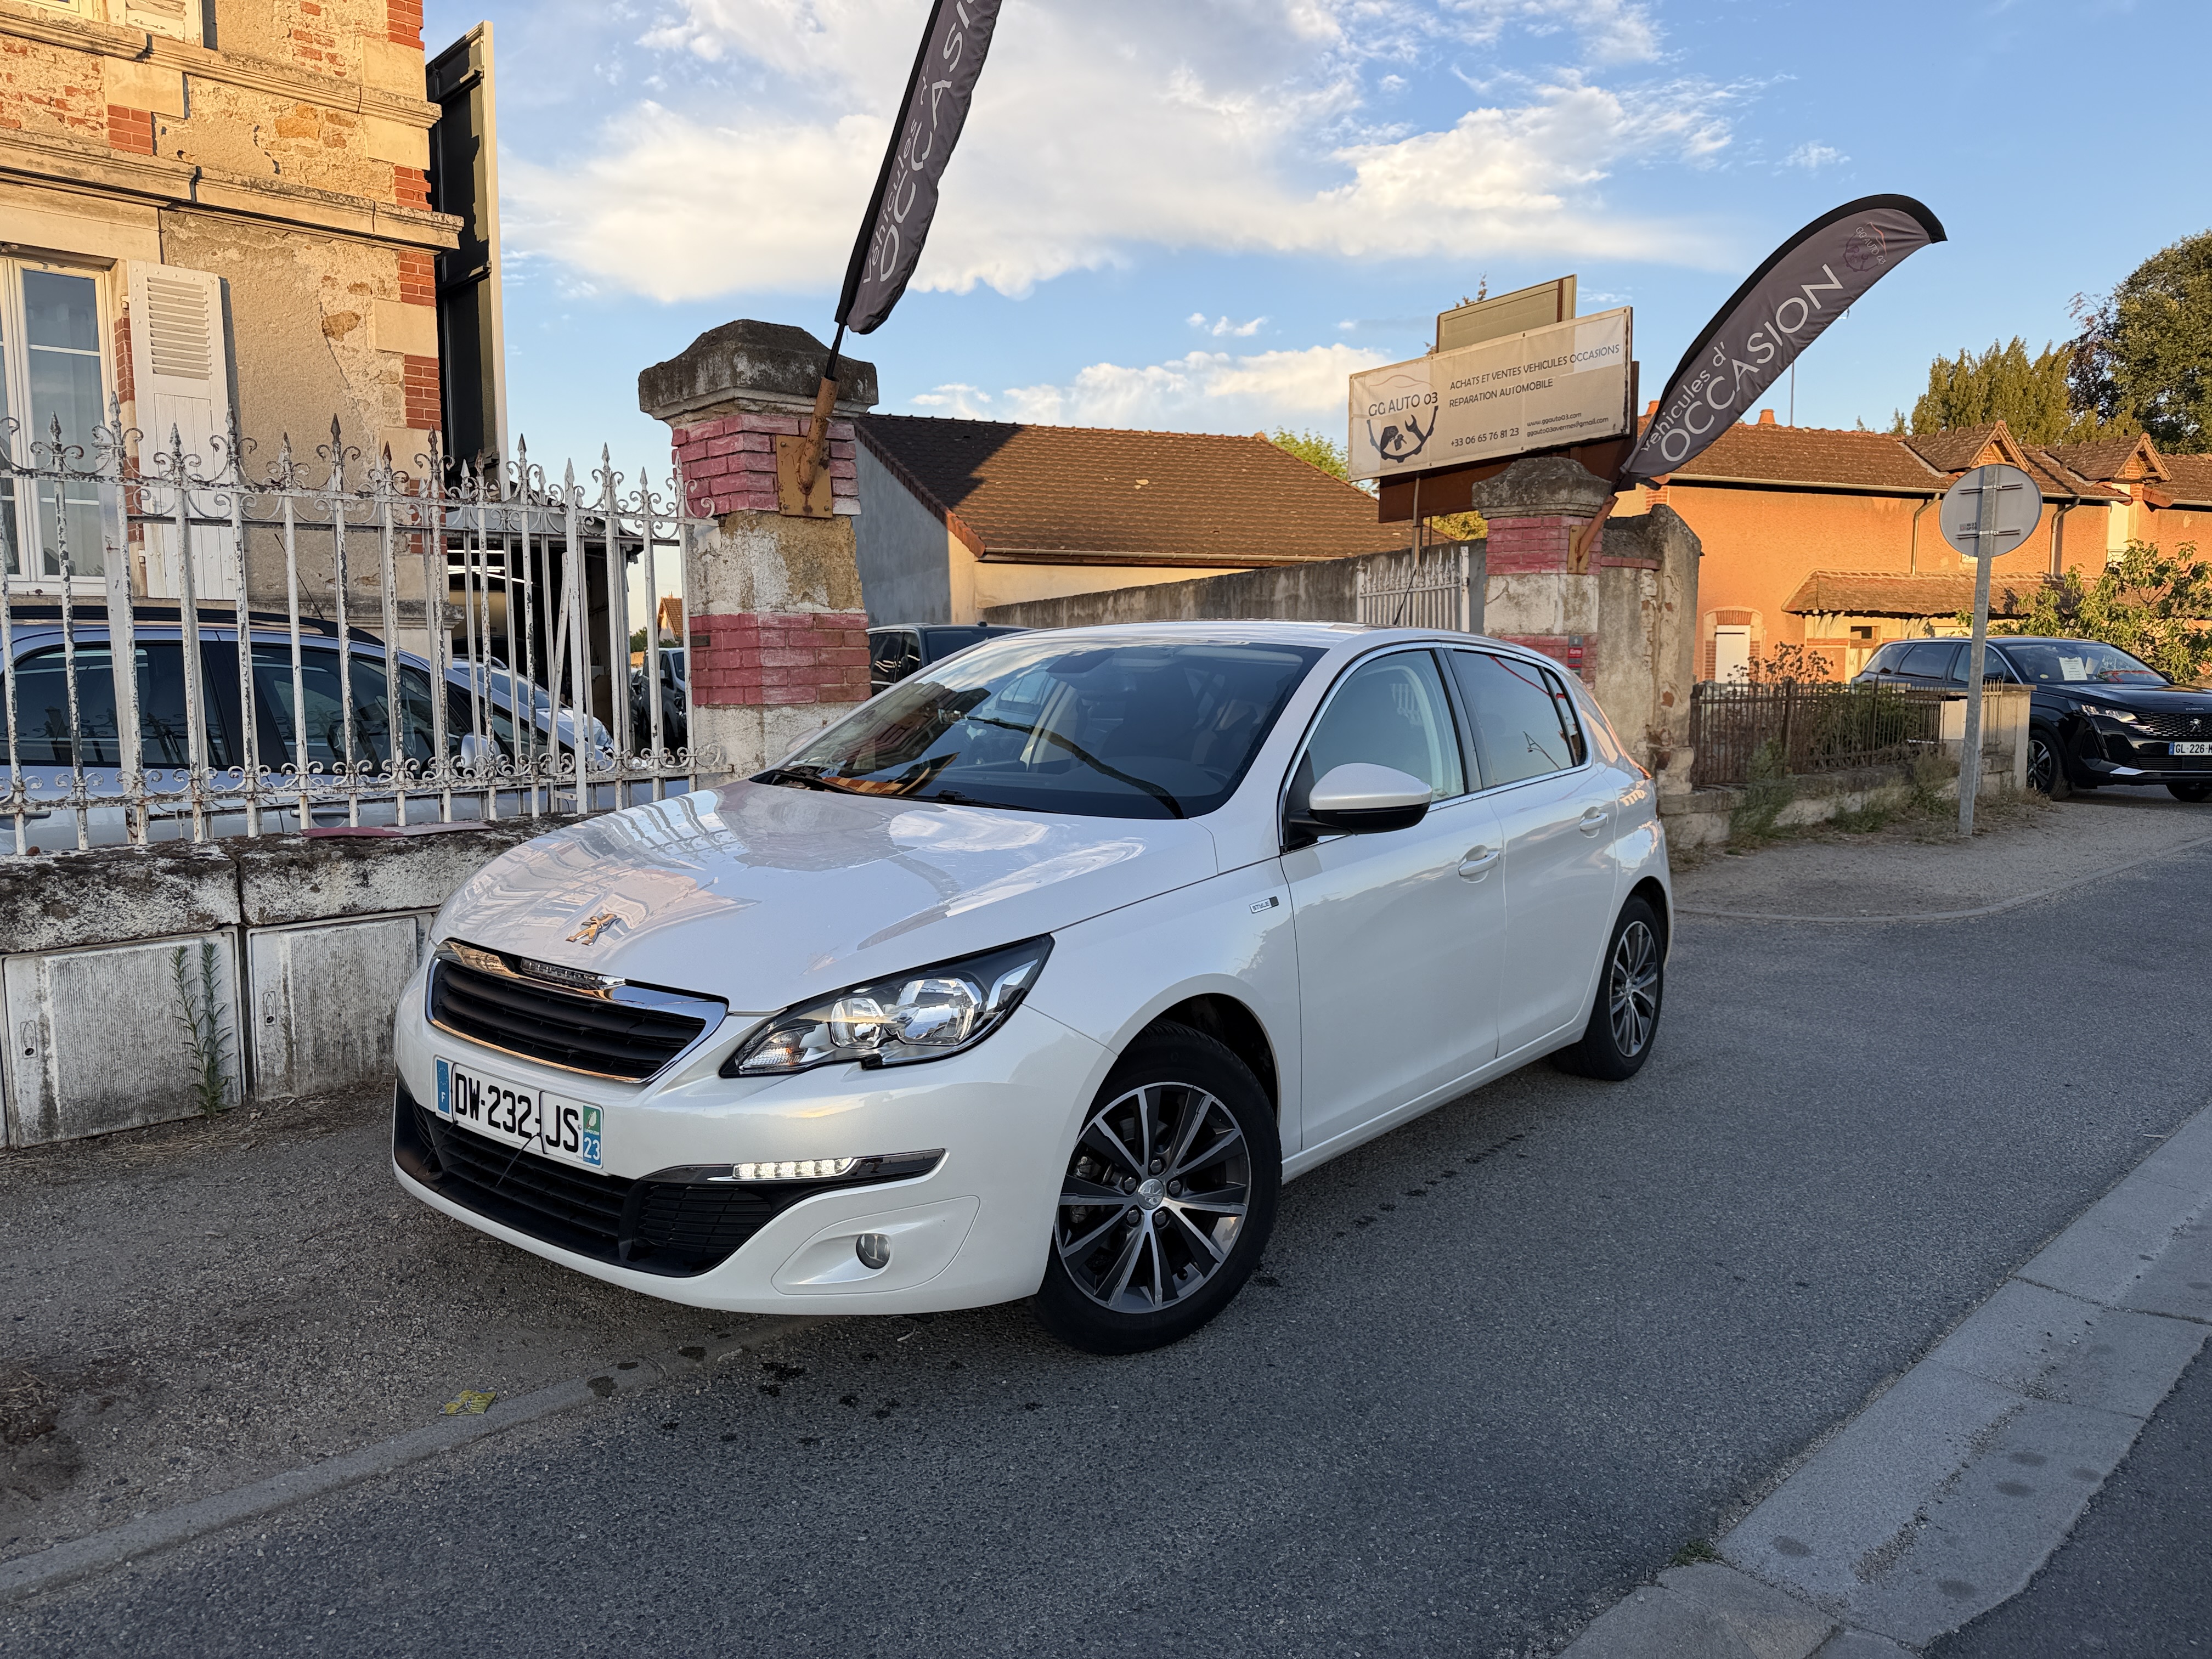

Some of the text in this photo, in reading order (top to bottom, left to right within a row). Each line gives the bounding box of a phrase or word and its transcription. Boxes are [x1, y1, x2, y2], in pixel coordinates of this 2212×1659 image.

[880, 0, 974, 282] OCCASI
[1856, 227, 1887, 264] GG AUTO 03
[1449, 343, 1620, 391] ACHATS ET VENTES VEHICULES OCCASIONS
[1661, 263, 1844, 462] OCCASION
[1713, 341, 1726, 367] d'
[1368, 392, 1438, 416] GG AUTO 03
[1449, 378, 1554, 408] REPARATION AUTOMOBILE
[1527, 412, 1582, 427] www.ggauto03.com
[1451, 427, 1520, 447] +33 06 65 76 81 23
[1252, 901, 1270, 911] STYLE
[441, 1091, 446, 1103] F
[455, 1072, 579, 1153] DW-232-JS
[584, 1137, 600, 1160] 23
